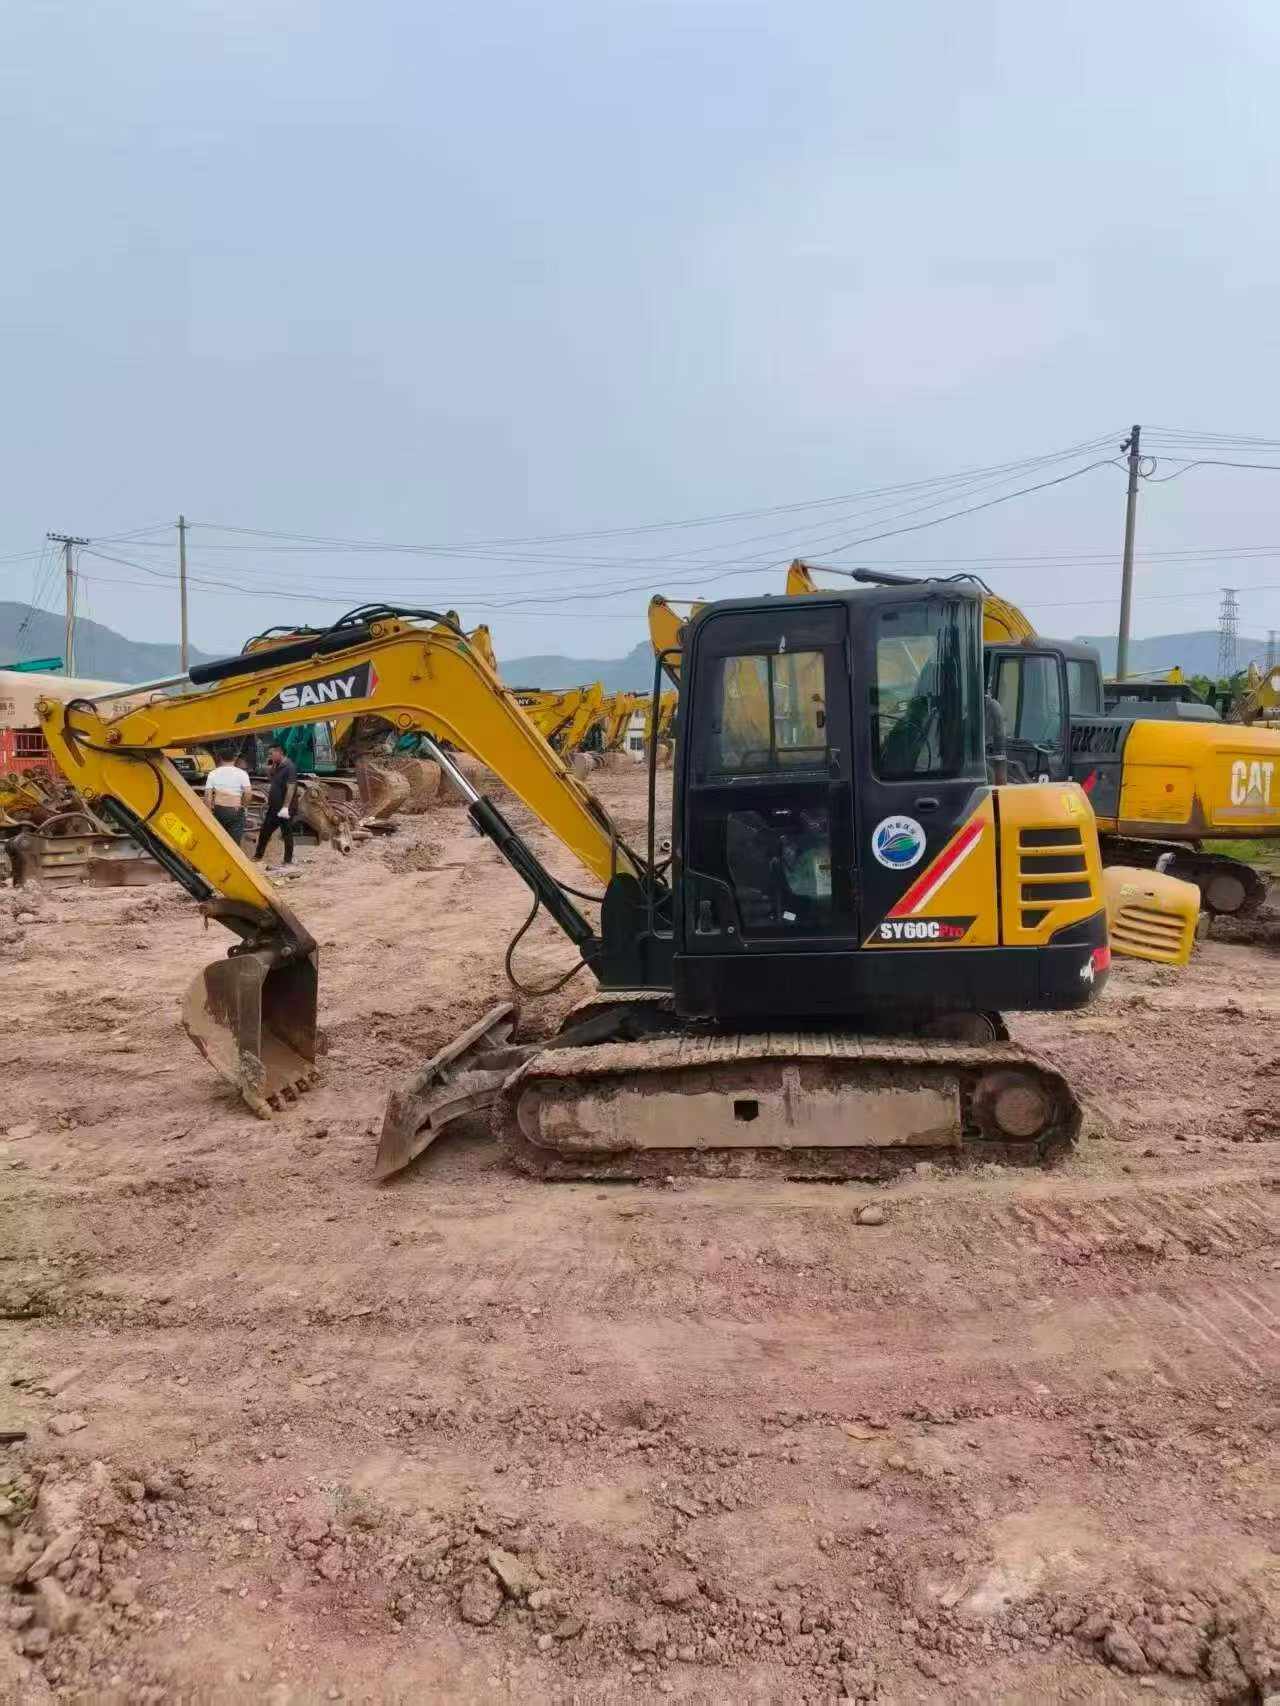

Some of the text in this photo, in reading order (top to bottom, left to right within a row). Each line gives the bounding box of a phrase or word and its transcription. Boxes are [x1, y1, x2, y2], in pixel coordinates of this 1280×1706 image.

[280, 676, 356, 710] SANY
[1231, 760, 1274, 806] CAT
[880, 922, 940, 939] SY60C
